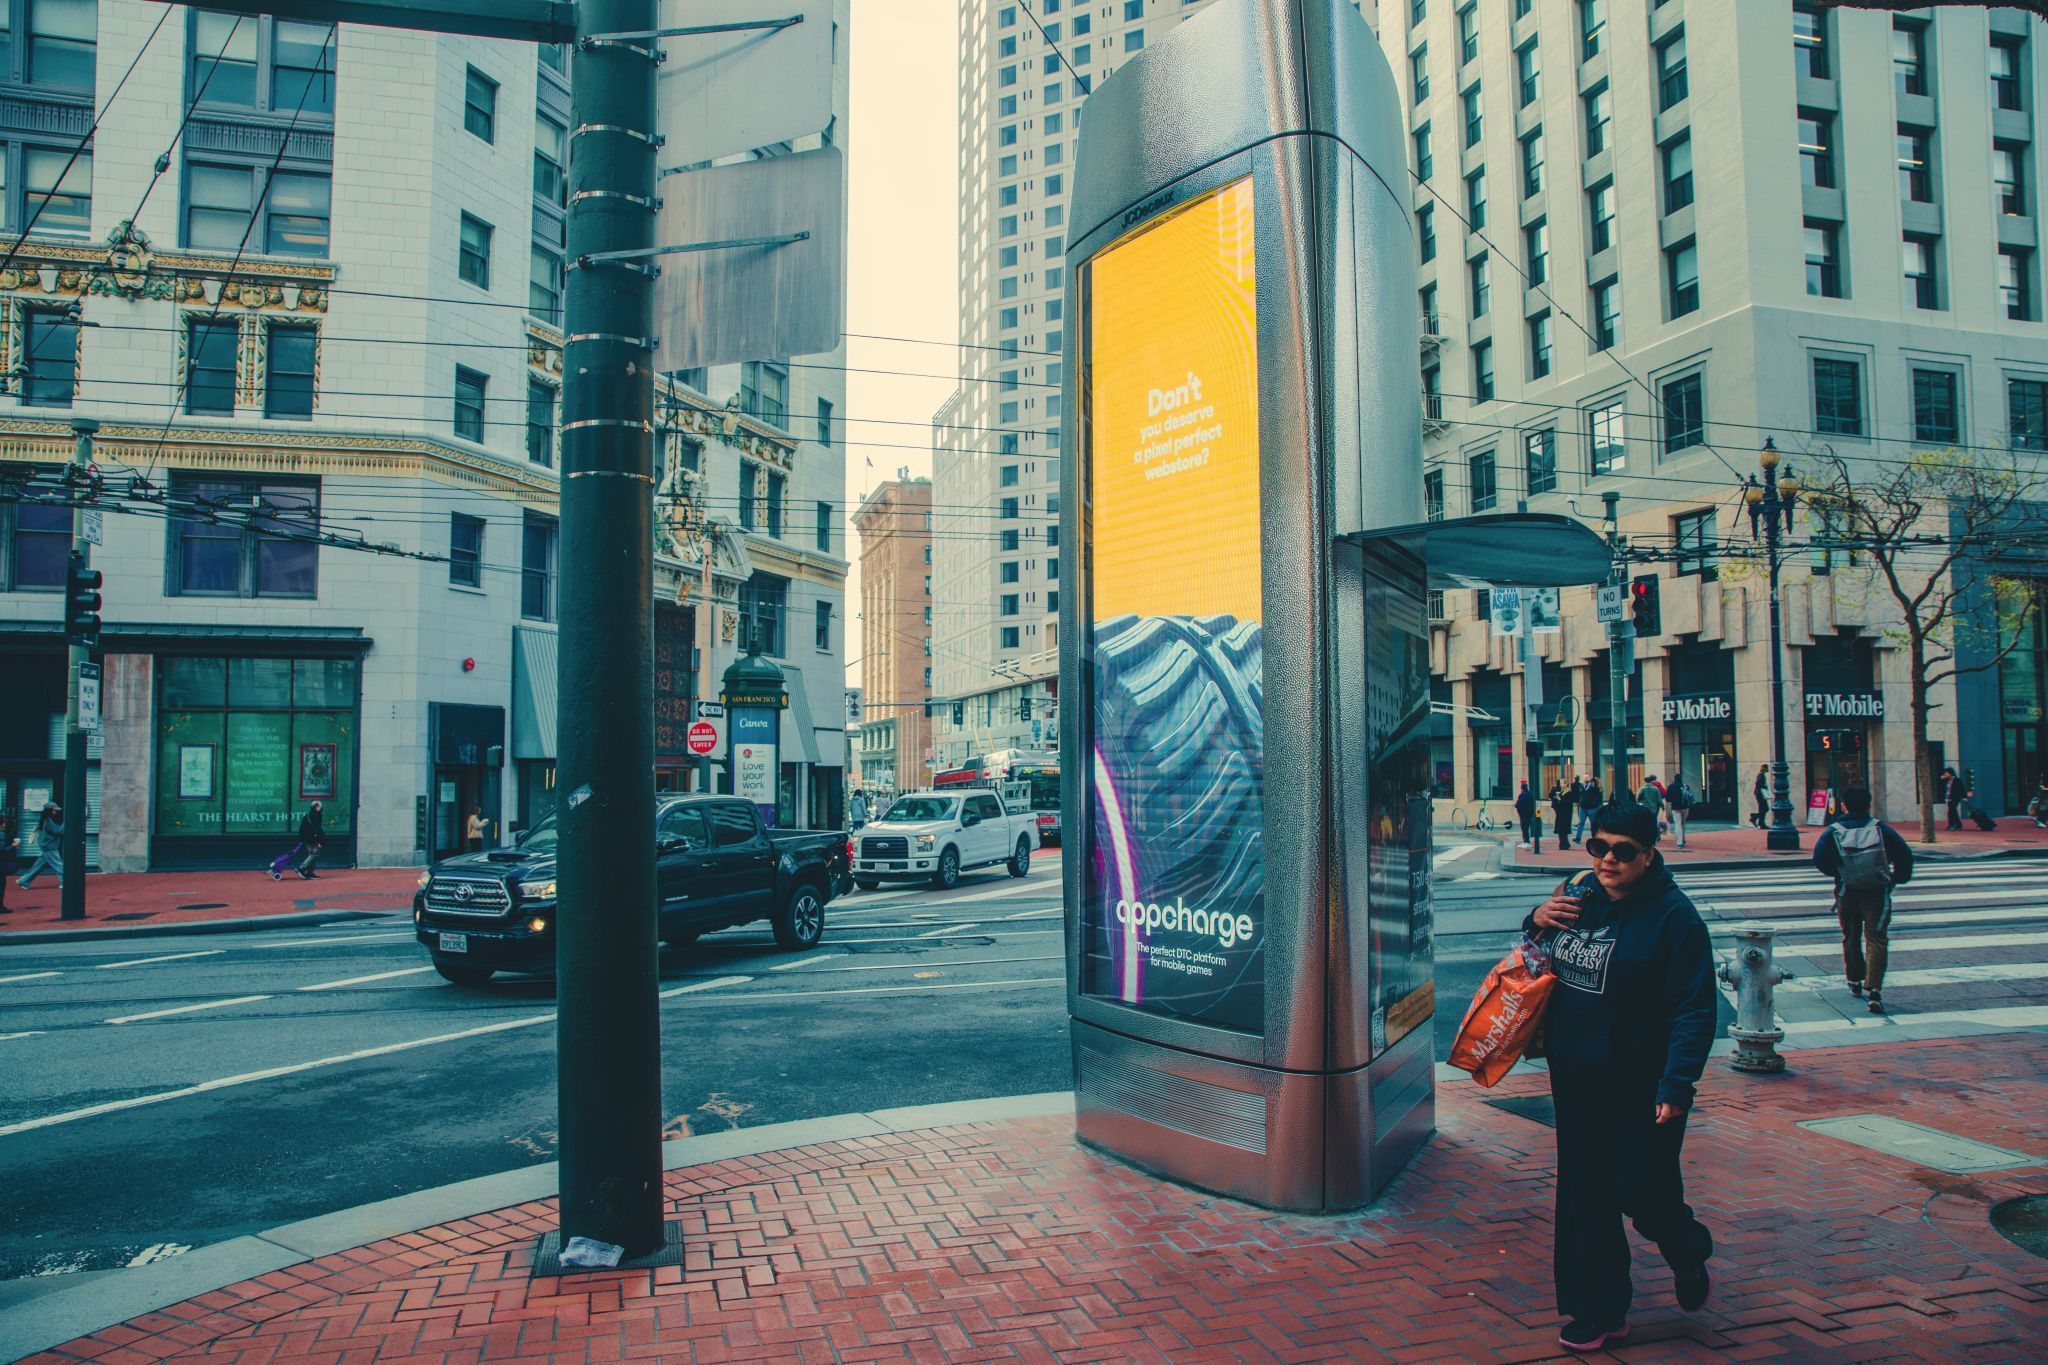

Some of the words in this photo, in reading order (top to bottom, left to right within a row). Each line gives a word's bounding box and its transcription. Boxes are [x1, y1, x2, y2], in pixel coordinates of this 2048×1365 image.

[1121, 190, 1174, 229] JCDecaux
[1148, 371, 1202, 417] Don't
[1140, 422, 1162, 445] you
[1164, 405, 1214, 432] deserve
[1134, 450, 1142, 463] a
[1144, 437, 1172, 464] pixel
[1174, 423, 1222, 456] perfect
[1145, 447, 1210, 480] webstore?
[1492, 593, 1520, 609] ASAWA
[1603, 592, 1615, 603] NO
[1600, 605, 1620, 617] TURNS
[740, 717, 768, 728] Canva
[1822, 735, 1830, 749] 5
[742, 762, 765, 771] Love
[198, 812, 223, 822] THE
[225, 812, 273, 822] HEARST
[1116, 896, 1253, 948] appcharge
[1136, 941, 1150, 953] The
[1150, 945, 1176, 958] perfect
[1176, 949, 1192, 960] DTC
[1193, 951, 1227, 967] platform
[1555, 946, 1576, 964] WAS
[1576, 954, 1603, 970] EASY
[1557, 934, 1572, 948] IF
[1569, 938, 1607, 958] RUGBY
[1150, 955, 1161, 967] for
[1161, 958, 1186, 971] mobile
[1186, 964, 1213, 977] games
[1471, 990, 1524, 1064] Marshalls
